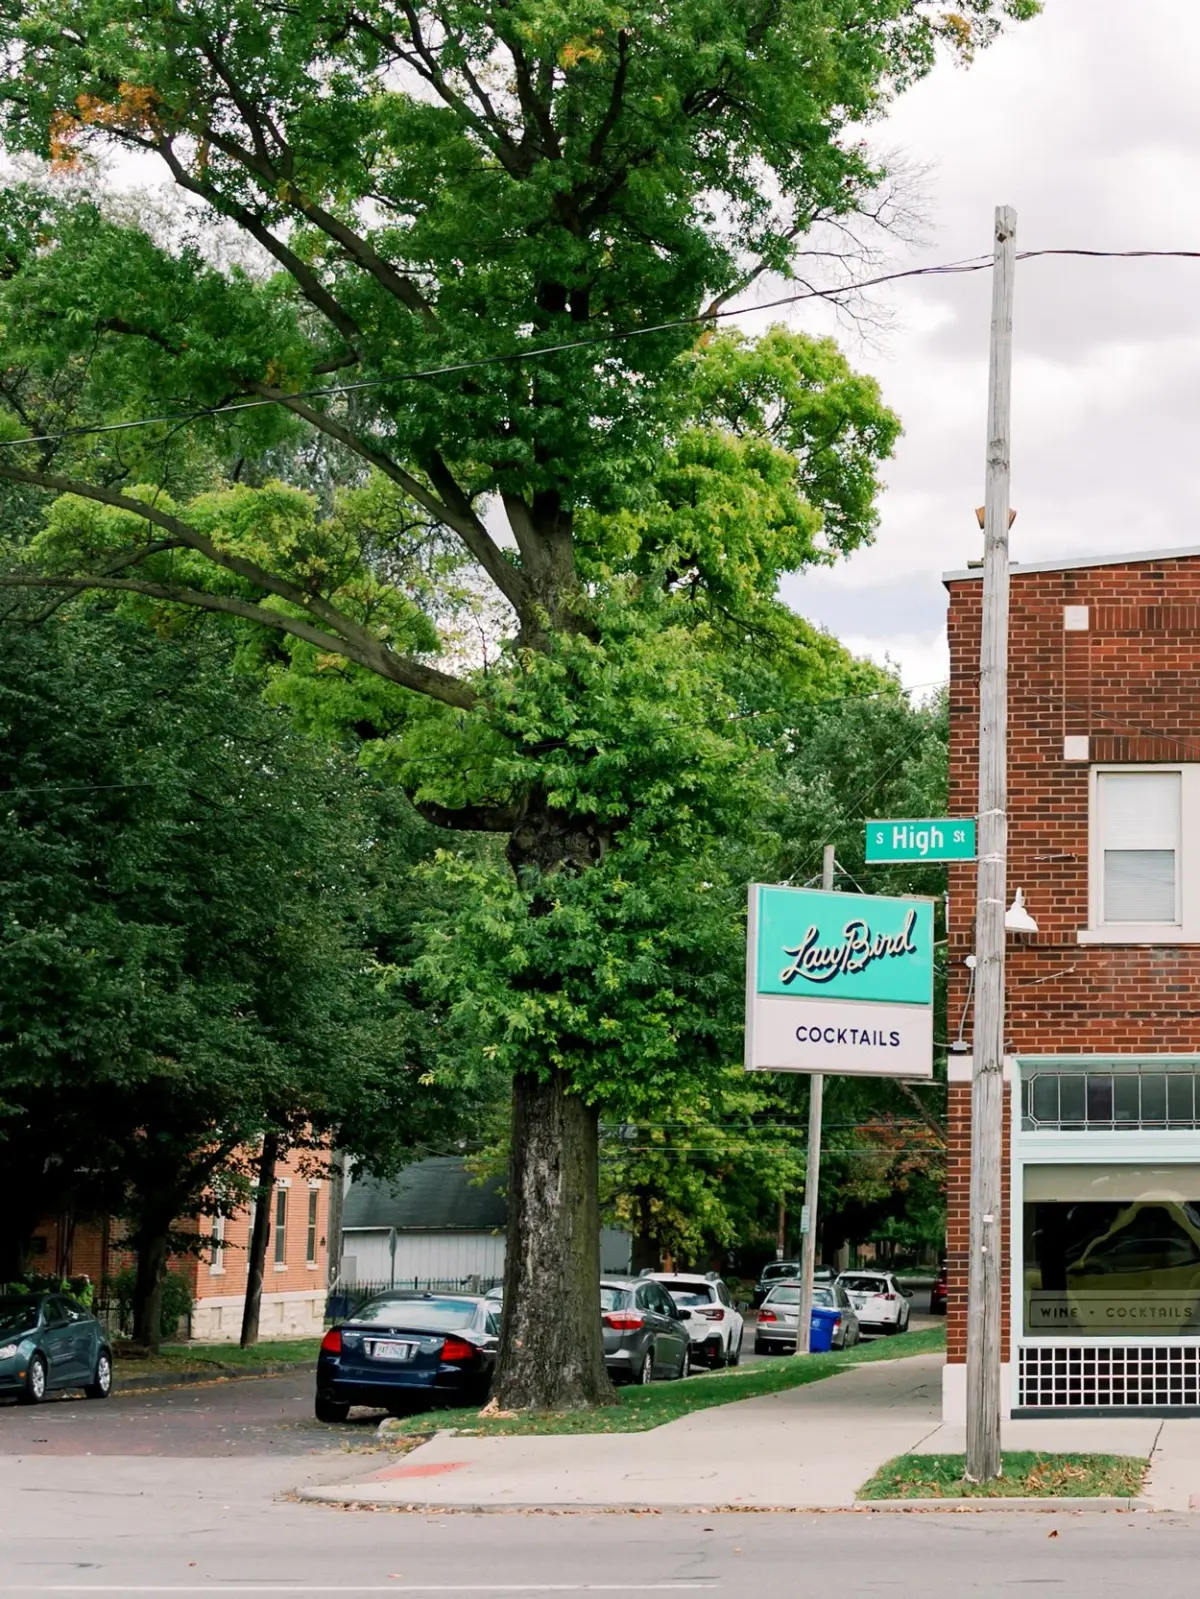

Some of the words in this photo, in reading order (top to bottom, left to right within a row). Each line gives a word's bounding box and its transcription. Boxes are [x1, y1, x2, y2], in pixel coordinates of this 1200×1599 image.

[875, 832, 884, 845] S
[892, 825, 944, 856] High
[952, 830, 965, 843] St
[795, 1026, 900, 1047] COCKTAILS
[1040, 1307, 1079, 1318] WINE
[1105, 1307, 1193, 1318] COCKTAILS
